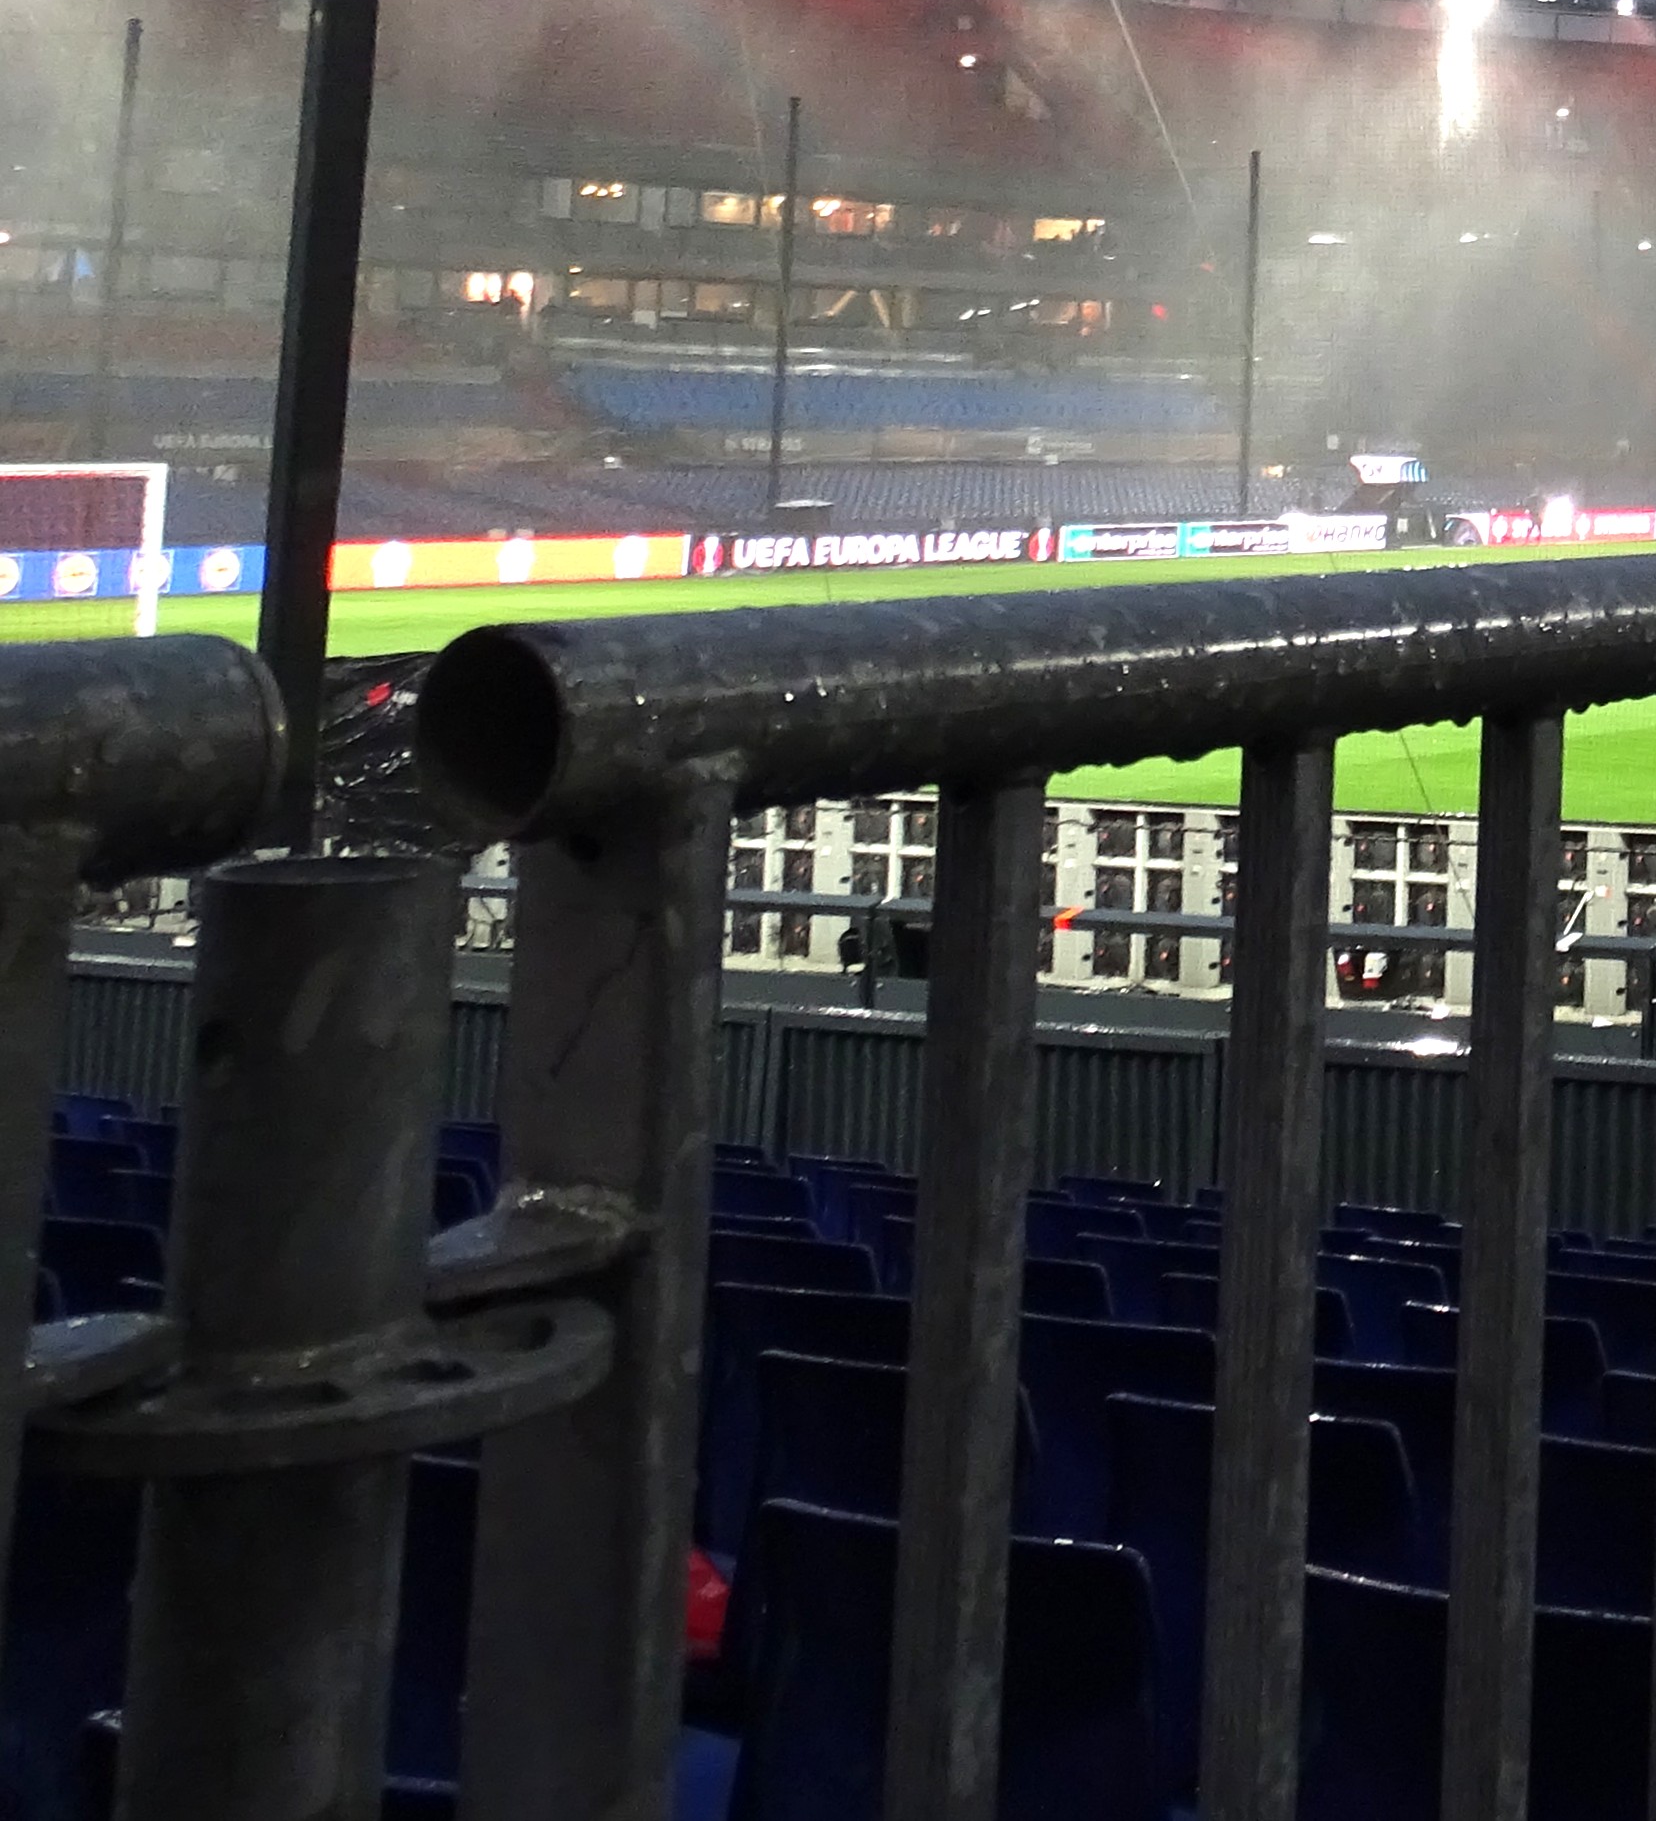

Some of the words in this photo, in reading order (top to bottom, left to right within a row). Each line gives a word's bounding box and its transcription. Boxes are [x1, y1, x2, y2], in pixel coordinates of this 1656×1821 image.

[733, 536, 810, 568] UEFA
[813, 533, 921, 566] EUROPA
[924, 530, 1022, 563] LEAGUE
[1070, 529, 1177, 554] enterprise
[1190, 526, 1288, 552] enterprise
